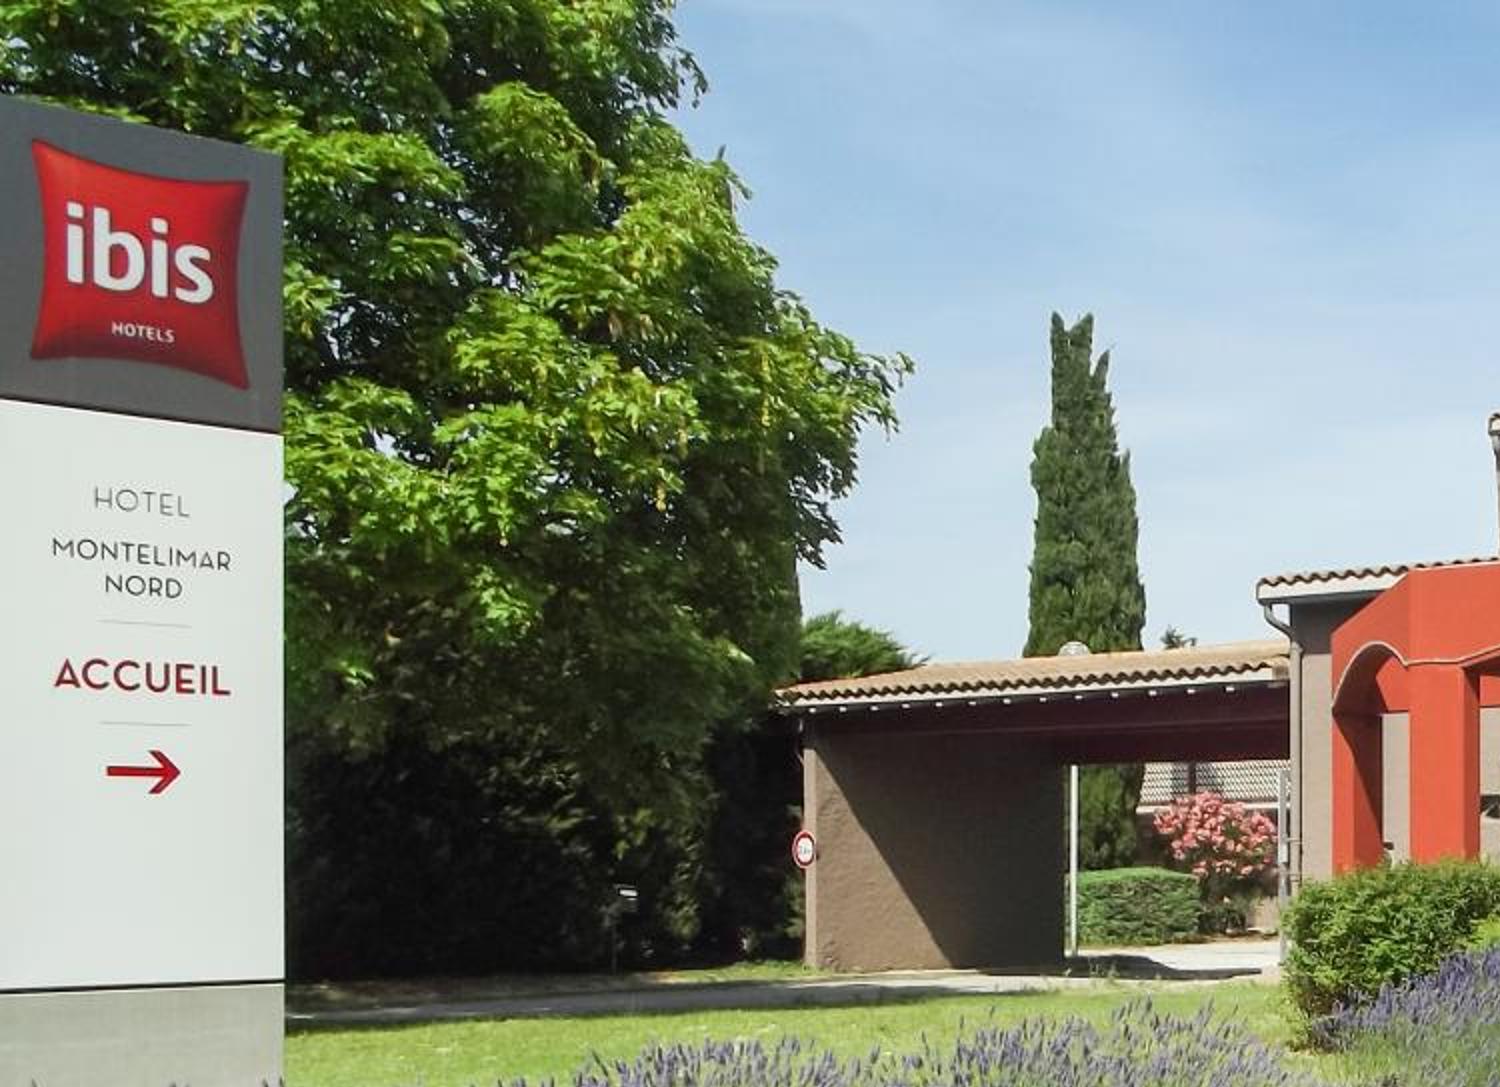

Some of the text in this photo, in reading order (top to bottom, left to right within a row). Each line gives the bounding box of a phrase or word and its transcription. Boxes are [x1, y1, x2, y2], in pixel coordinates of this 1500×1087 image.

[66, 201, 214, 304] ibis
[111, 321, 175, 343] HOTELS
[94, 486, 190, 518] HOTEL
[52, 538, 231, 570] MONTELIMAR
[105, 575, 183, 599] NORD
[54, 658, 231, 696] ACCUEIL
